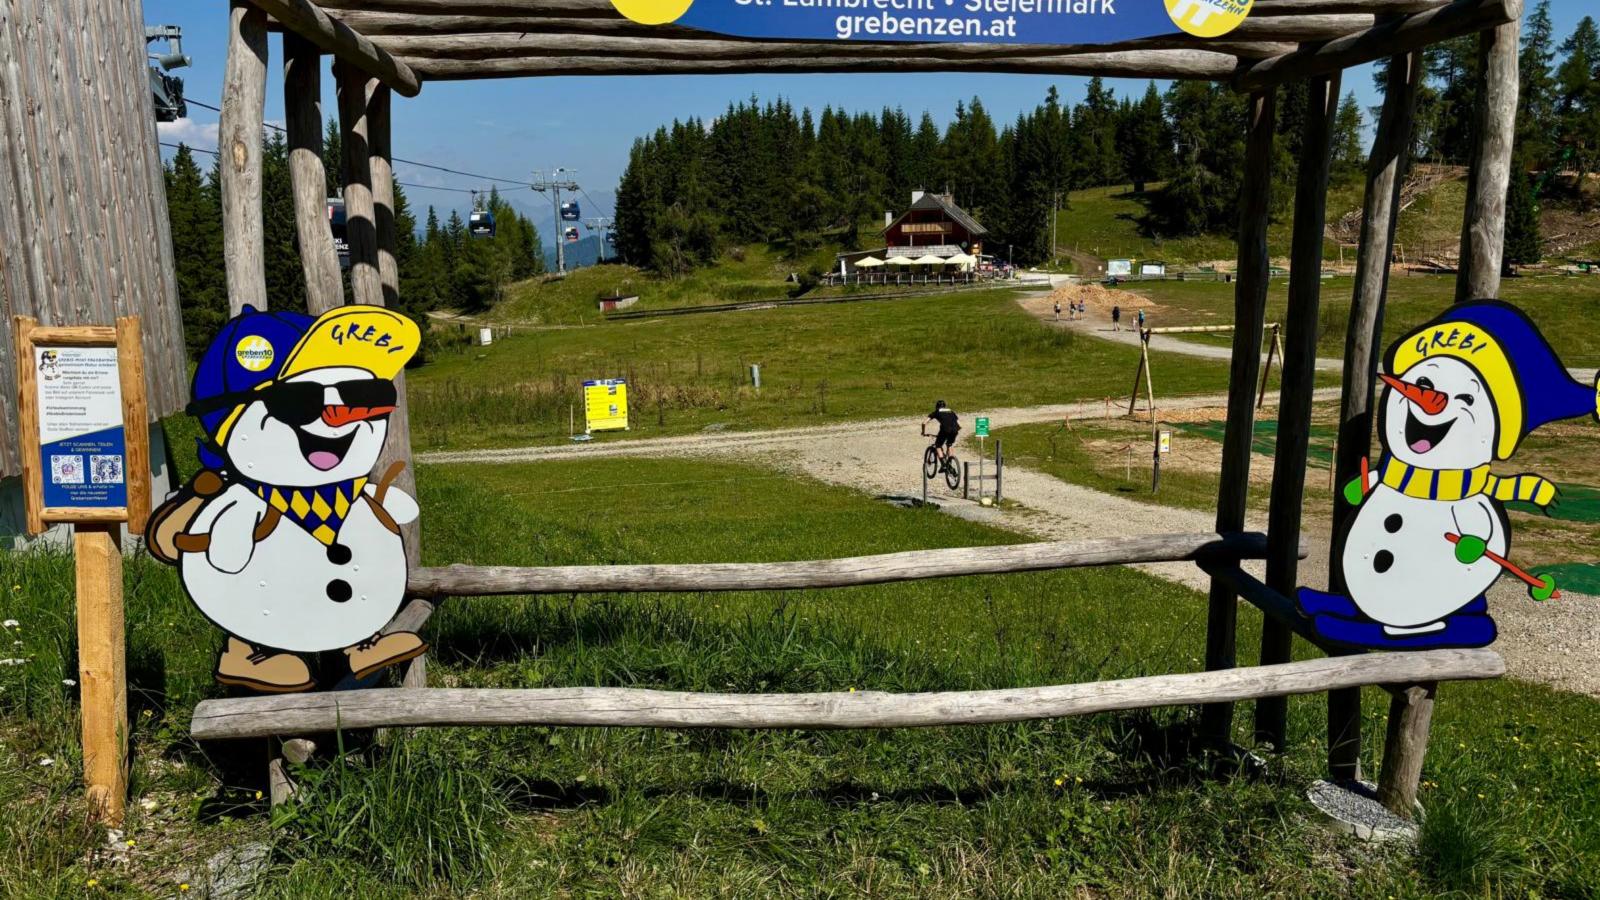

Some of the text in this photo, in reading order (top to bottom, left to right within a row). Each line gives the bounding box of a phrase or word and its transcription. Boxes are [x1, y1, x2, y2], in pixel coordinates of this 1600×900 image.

[835, 11, 1016, 38] grebenzen.at
[331, 322, 404, 354] GREBI
[1415, 328, 1487, 357] GREBI
[237, 349, 273, 357] greben10
